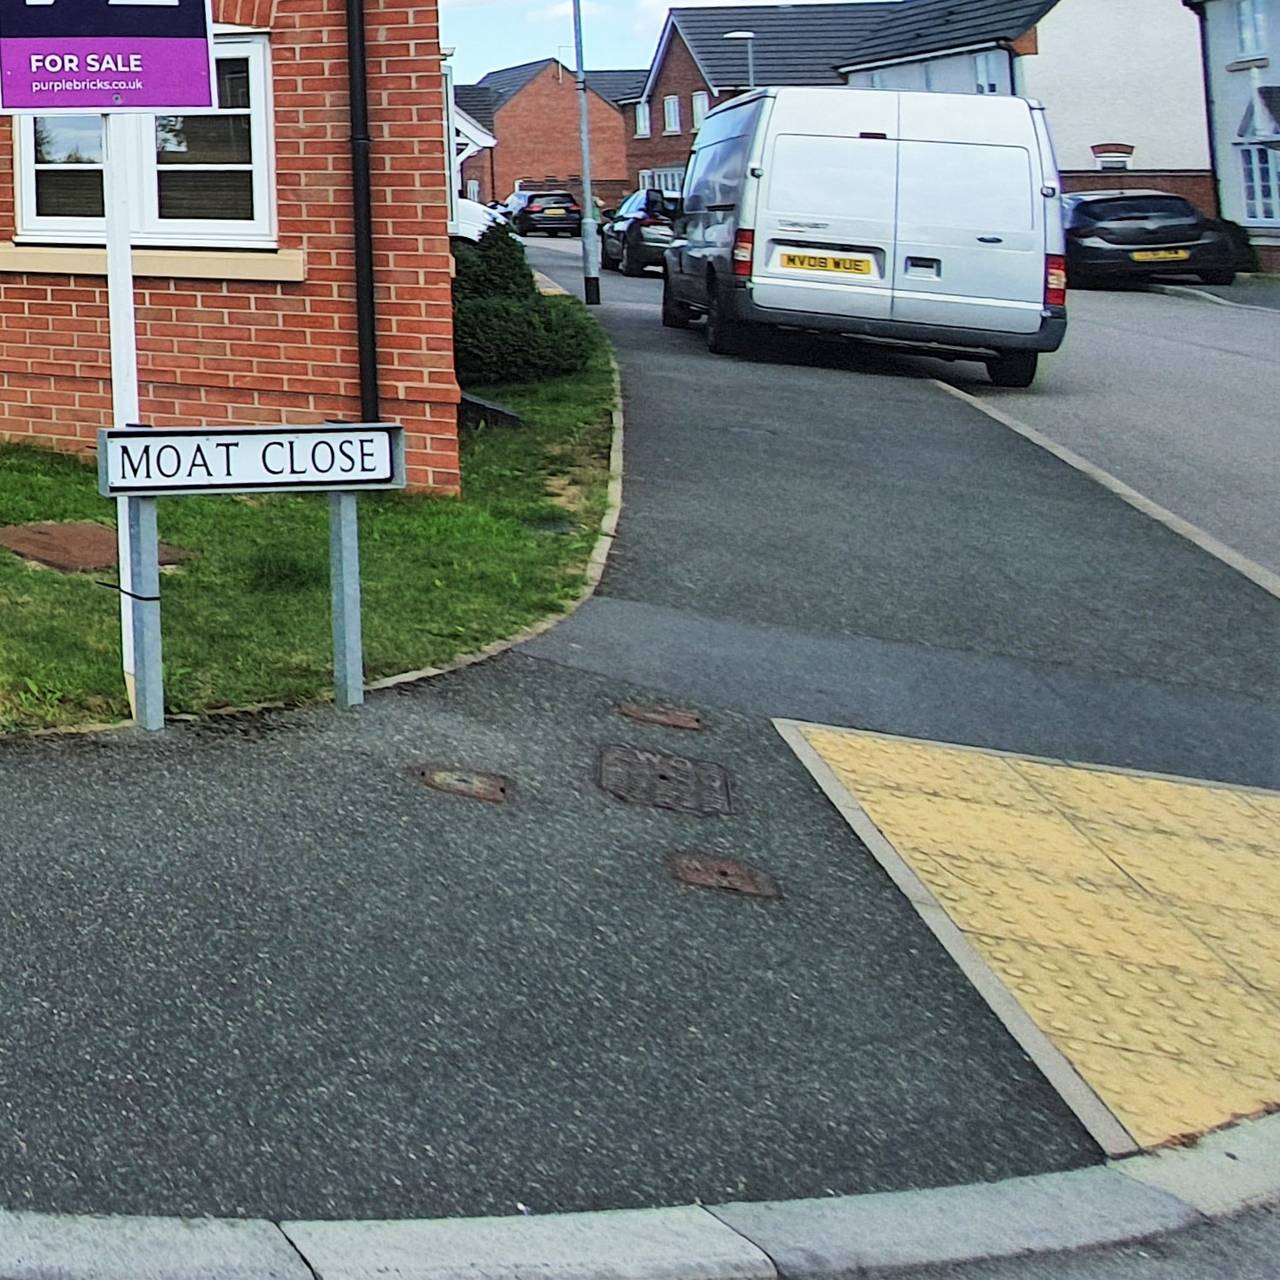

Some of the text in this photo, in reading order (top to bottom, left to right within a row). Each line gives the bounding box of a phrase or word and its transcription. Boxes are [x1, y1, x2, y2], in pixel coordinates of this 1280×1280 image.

[30, 54, 143, 72] FOR SALE
[32, 79, 143, 93] purplebricks.co.uk
[120, 438, 377, 479] MOAT CLOSE
